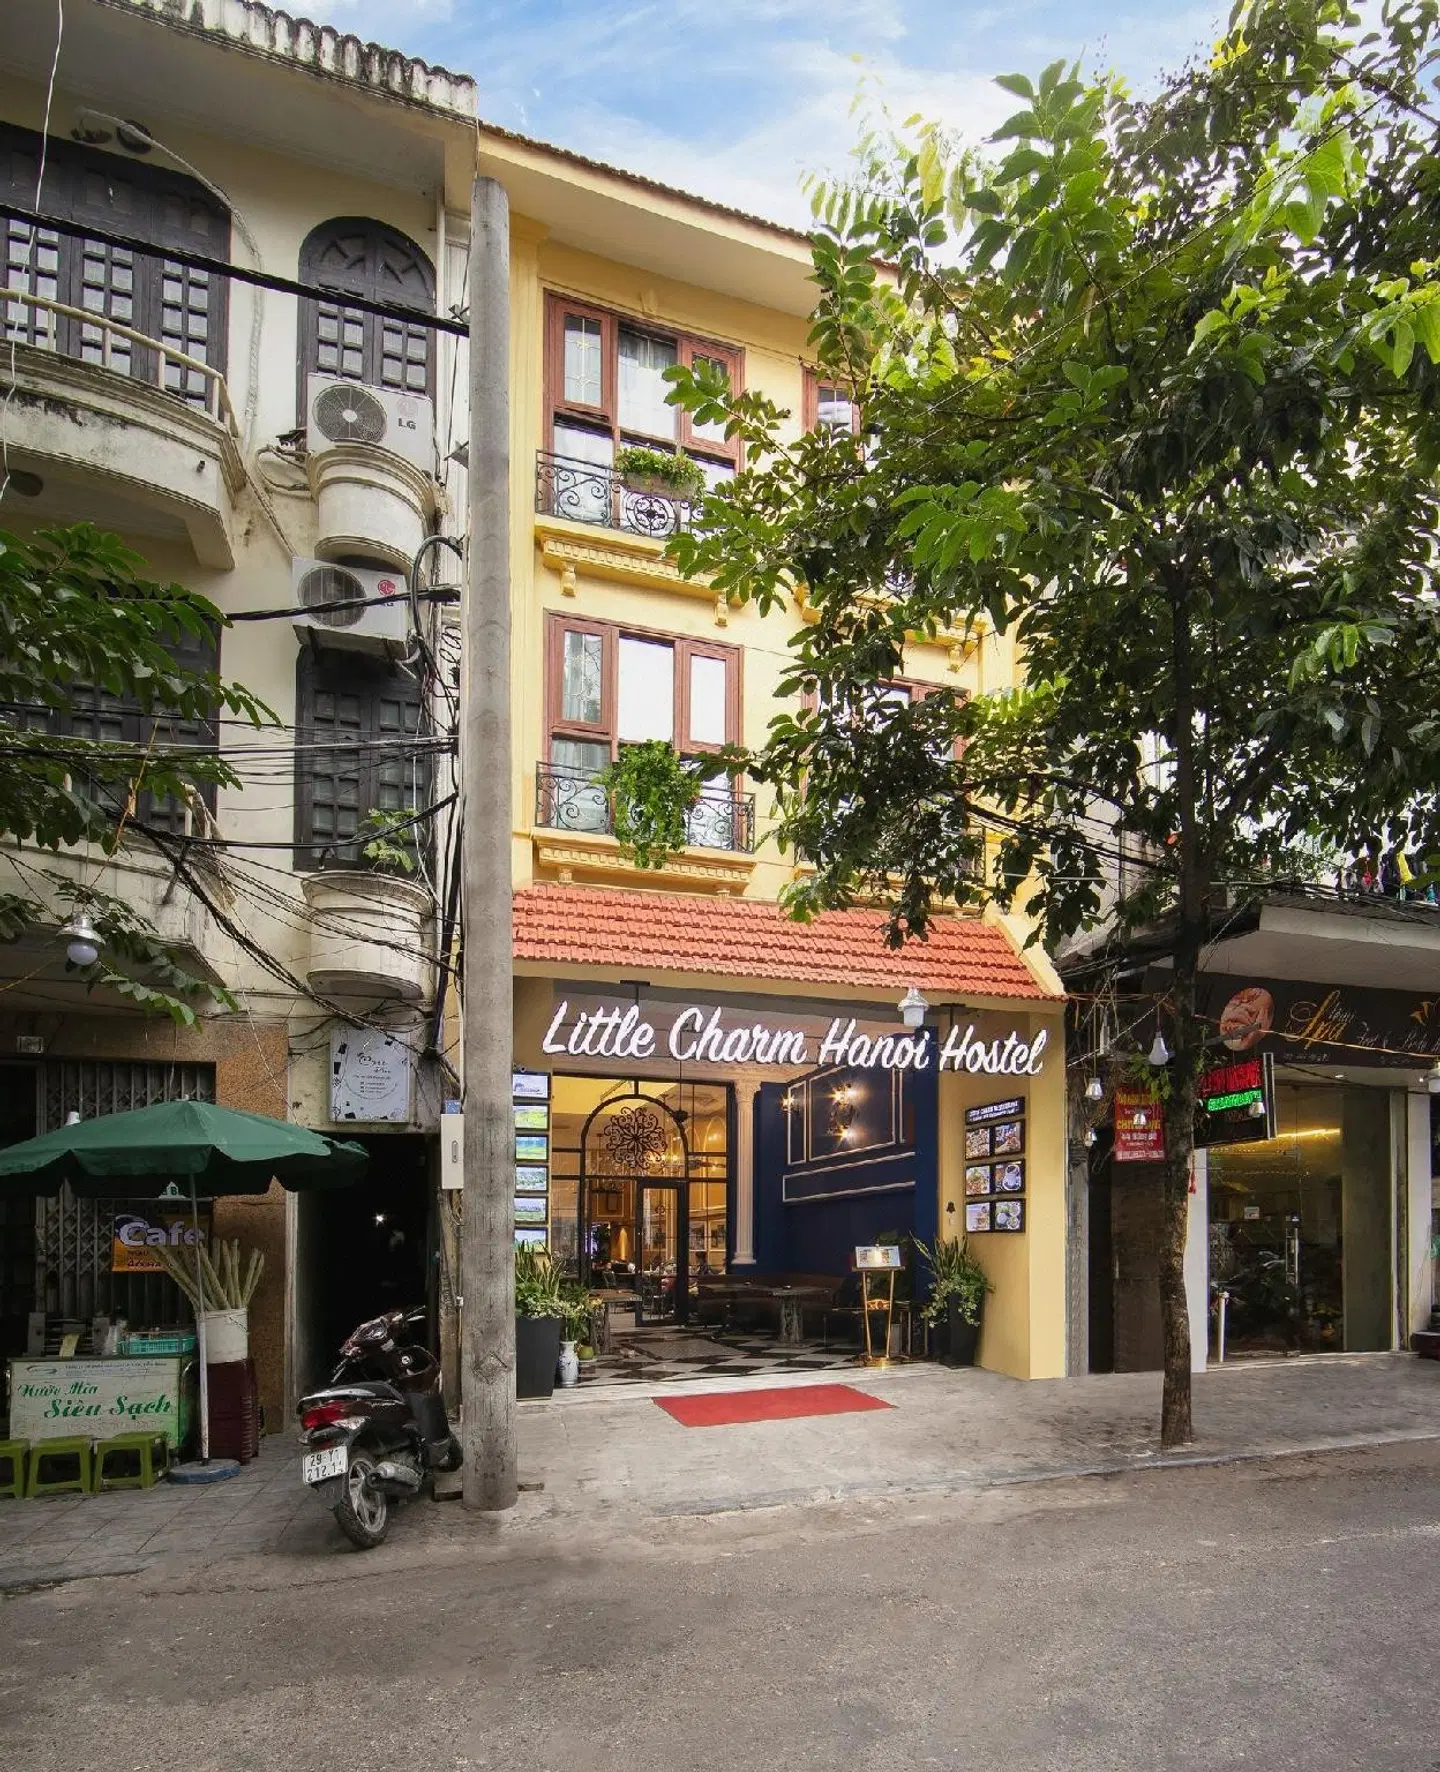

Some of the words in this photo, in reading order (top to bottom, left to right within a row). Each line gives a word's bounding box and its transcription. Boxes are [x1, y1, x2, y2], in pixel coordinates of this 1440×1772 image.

[398, 418, 416, 430] LG
[542, 1000, 656, 1058] Little
[669, 1006, 807, 1064] Charm
[818, 1017, 930, 1069] Hanoi
[939, 1024, 1047, 1075] Hostel
[119, 1220, 206, 1247] Cafe
